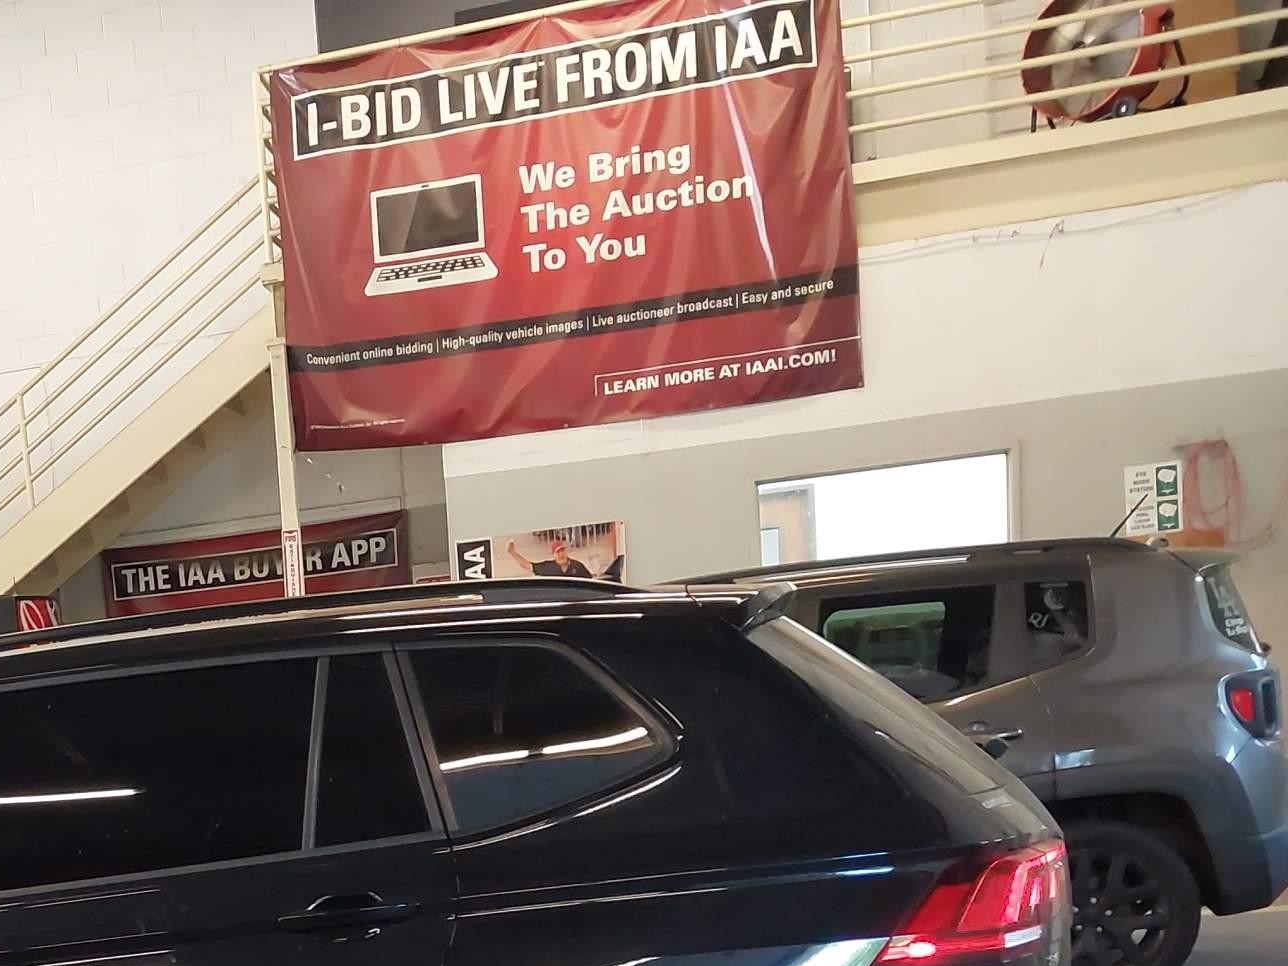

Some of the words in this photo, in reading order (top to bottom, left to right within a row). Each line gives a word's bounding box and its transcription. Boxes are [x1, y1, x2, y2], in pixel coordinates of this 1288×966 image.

[307, 87, 421, 146] I-BID
[556, 31, 697, 103] FROM
[715, 10, 803, 73] IAA
[519, 161, 575, 194] We
[588, 144, 691, 183] Bring
[520, 202, 591, 233] The
[602, 175, 754, 221] Auction
[522, 243, 566, 273] To
[576, 233, 646, 264] You
[306, 351, 360, 365] Convenient
[362, 346, 393, 360] online
[396, 341, 433, 356] bidding
[442, 331, 503, 350] High-quality
[505, 325, 543, 341] vehicle
[545, 319, 583, 335] images
[592, 313, 614, 329] Live
[616, 305, 674, 324] auctioneer
[677, 296, 733, 314] broadcast
[742, 291, 768, 306] Easy
[771, 286, 792, 301] and
[794, 279, 834, 296] secure
[604, 374, 659, 396] LEARN
[664, 366, 715, 387] MORE
[719, 363, 741, 379] AT
[745, 349, 836, 375] IAAI.COM!
[121, 564, 172, 593] THE
[178, 559, 226, 587] IAA
[234, 548, 322, 581] BUYR
[330, 536, 387, 569] APP
